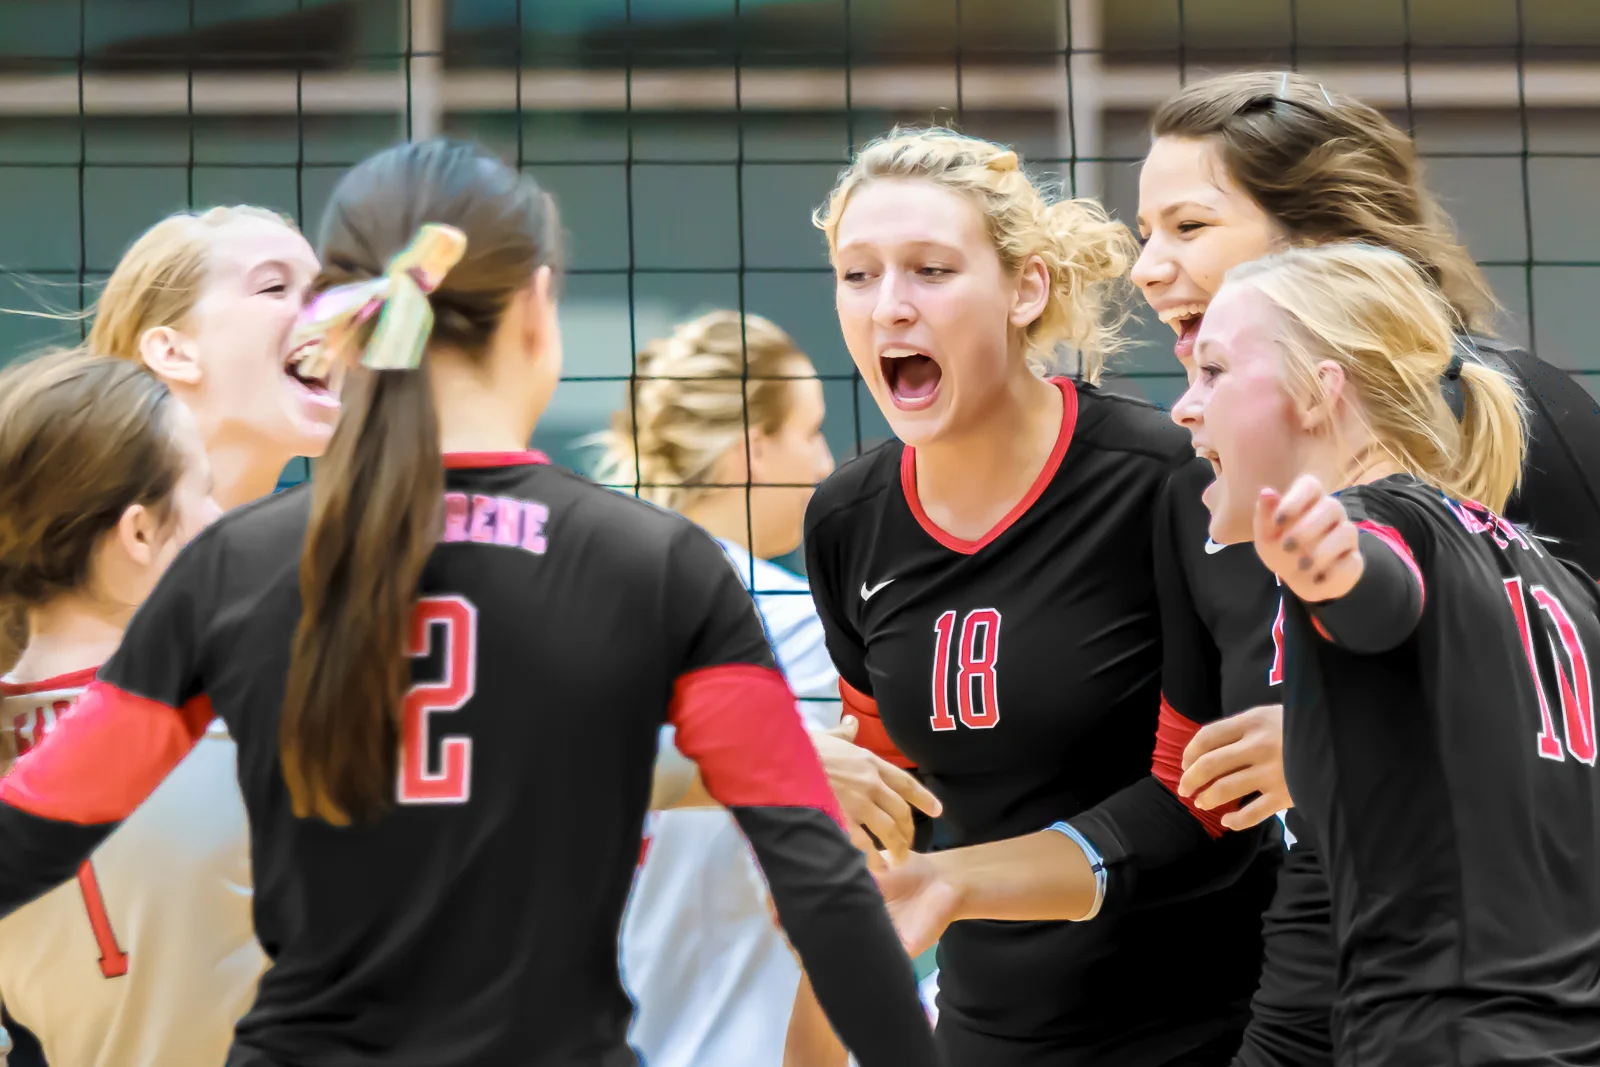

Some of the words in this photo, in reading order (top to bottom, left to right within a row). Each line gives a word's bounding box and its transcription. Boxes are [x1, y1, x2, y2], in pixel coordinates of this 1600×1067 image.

[398, 595, 478, 804] 2
[930, 608, 1001, 731] 18
[1503, 576, 1597, 767] 10
